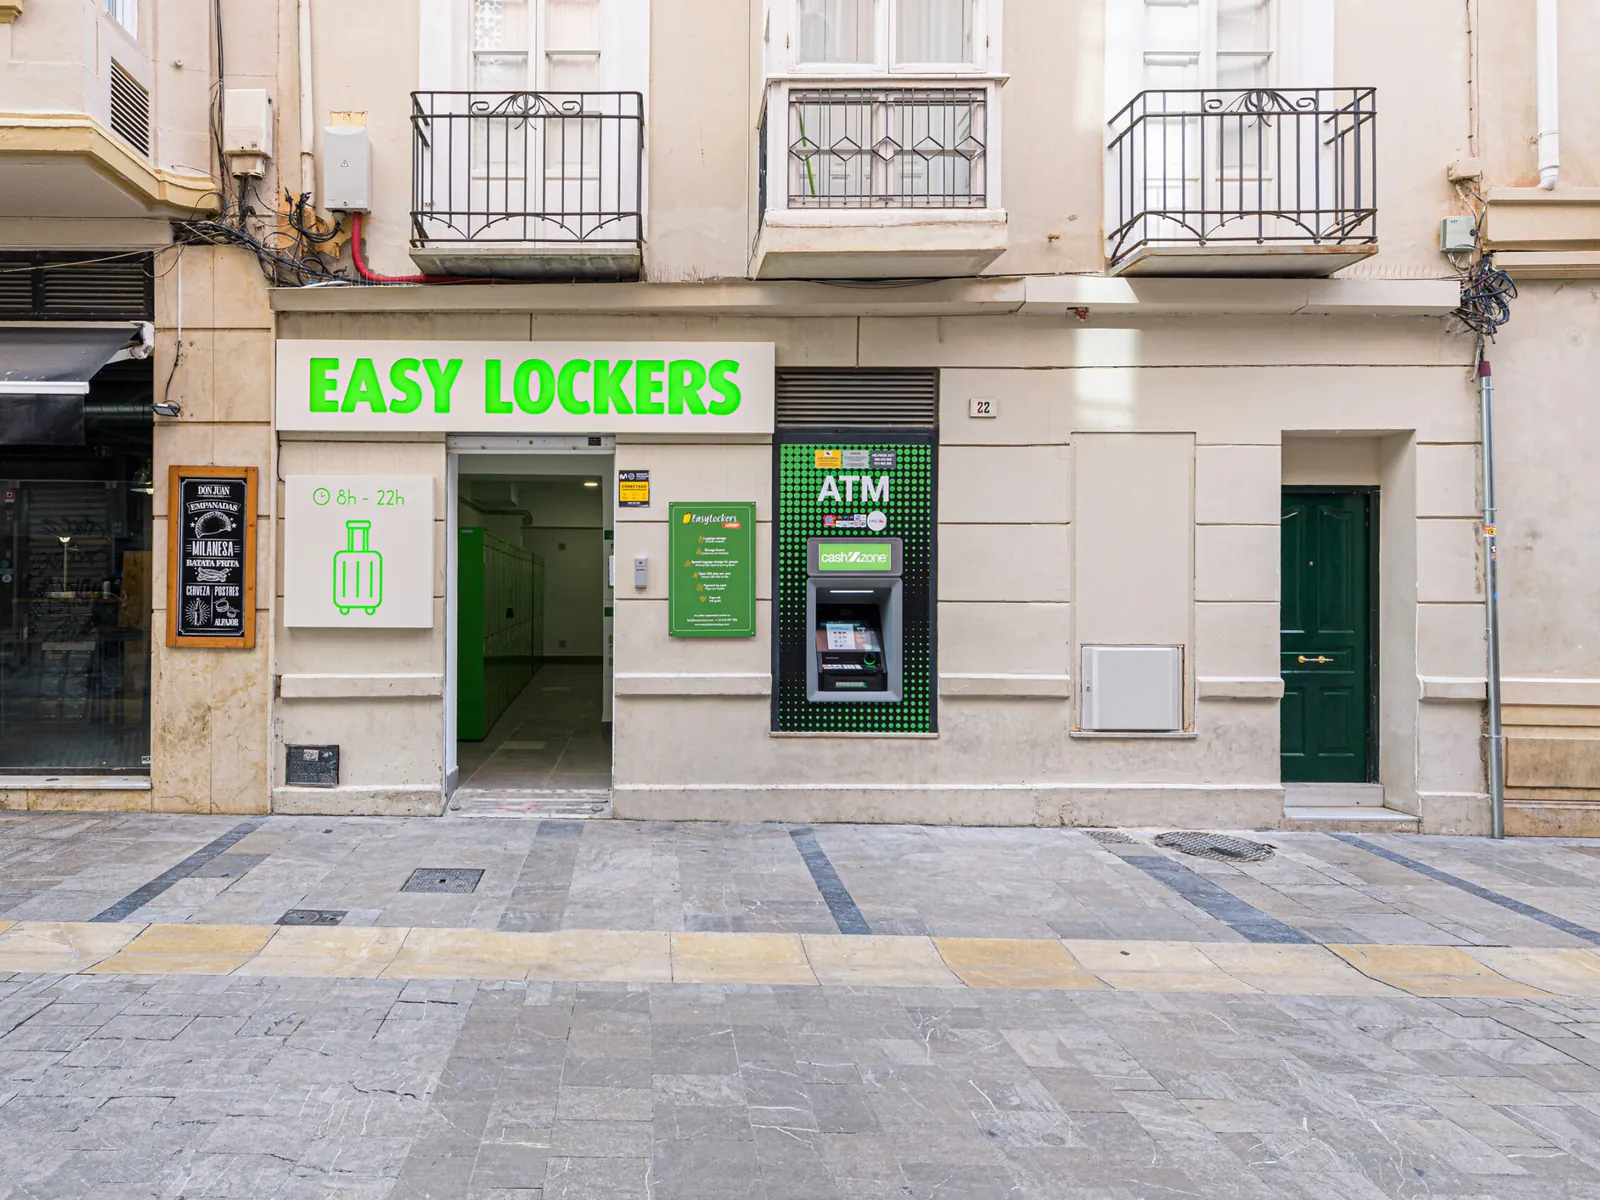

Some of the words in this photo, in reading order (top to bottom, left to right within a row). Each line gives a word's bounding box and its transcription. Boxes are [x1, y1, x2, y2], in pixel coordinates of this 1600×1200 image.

[309, 357, 463, 414] EASY
[485, 358, 741, 416] LOCKERS
[977, 401, 990, 414] 22
[198, 486, 212, 495] DON
[212, 486, 230, 495] JUAN
[817, 475, 890, 502] ATM
[336, 489, 357, 505] 8h
[376, 489, 405, 505] 22h
[190, 501, 238, 512] EMPANADAS
[192, 540, 234, 557] MILANESA
[186, 559, 215, 567] BATATA
[186, 585, 210, 596] CERVEZA
[214, 586, 239, 597] POSTRES
[214, 618, 239, 626] ALFAJOR
